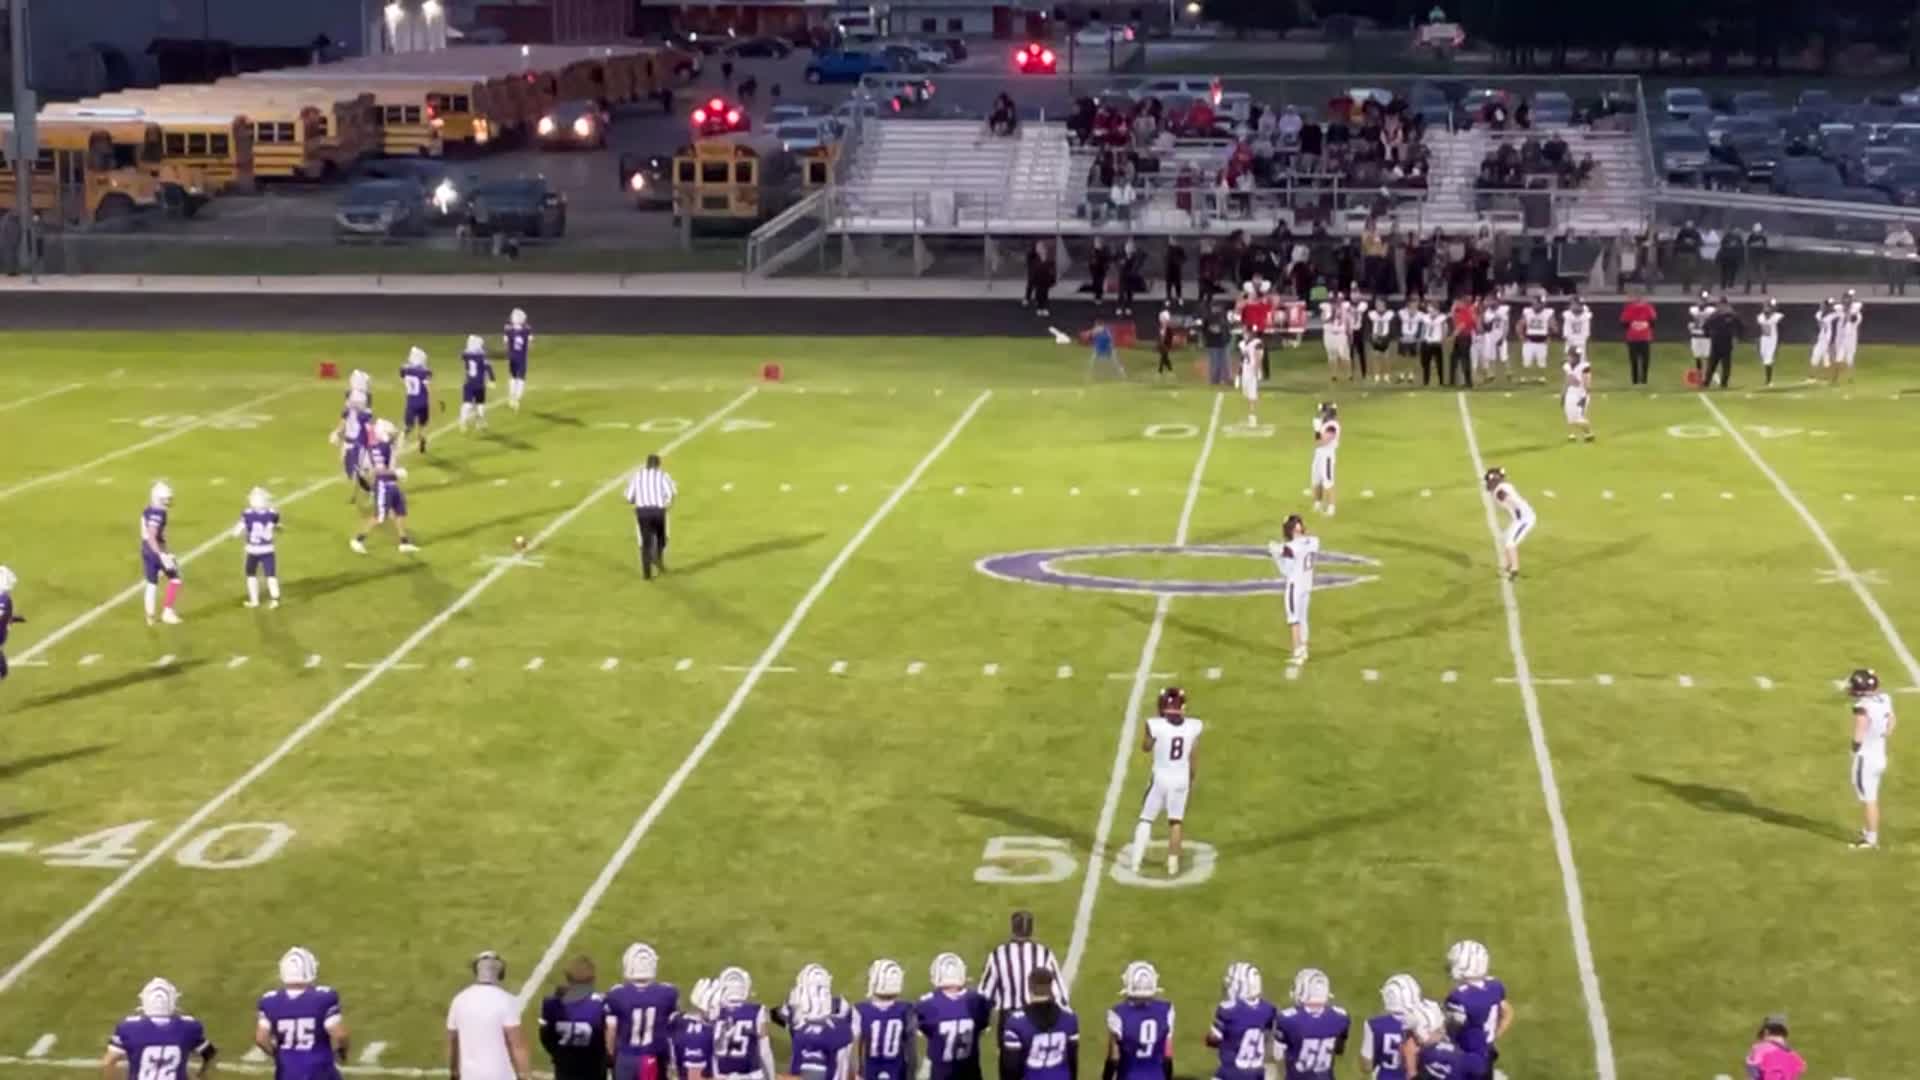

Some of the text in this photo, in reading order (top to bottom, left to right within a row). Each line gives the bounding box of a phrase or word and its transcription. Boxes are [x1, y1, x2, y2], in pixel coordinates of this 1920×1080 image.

[1169, 735, 1185, 761] 8
[38, 819, 297, 870] 40
[973, 835, 1219, 889] 50
[277, 1017, 316, 1051] 75
[629, 1007, 656, 1046] 11
[870, 1018, 903, 1058] 10
[1136, 1018, 1157, 1058] 9
[137, 1045, 182, 1080] 62
[1382, 1032, 1402, 1070] 5
